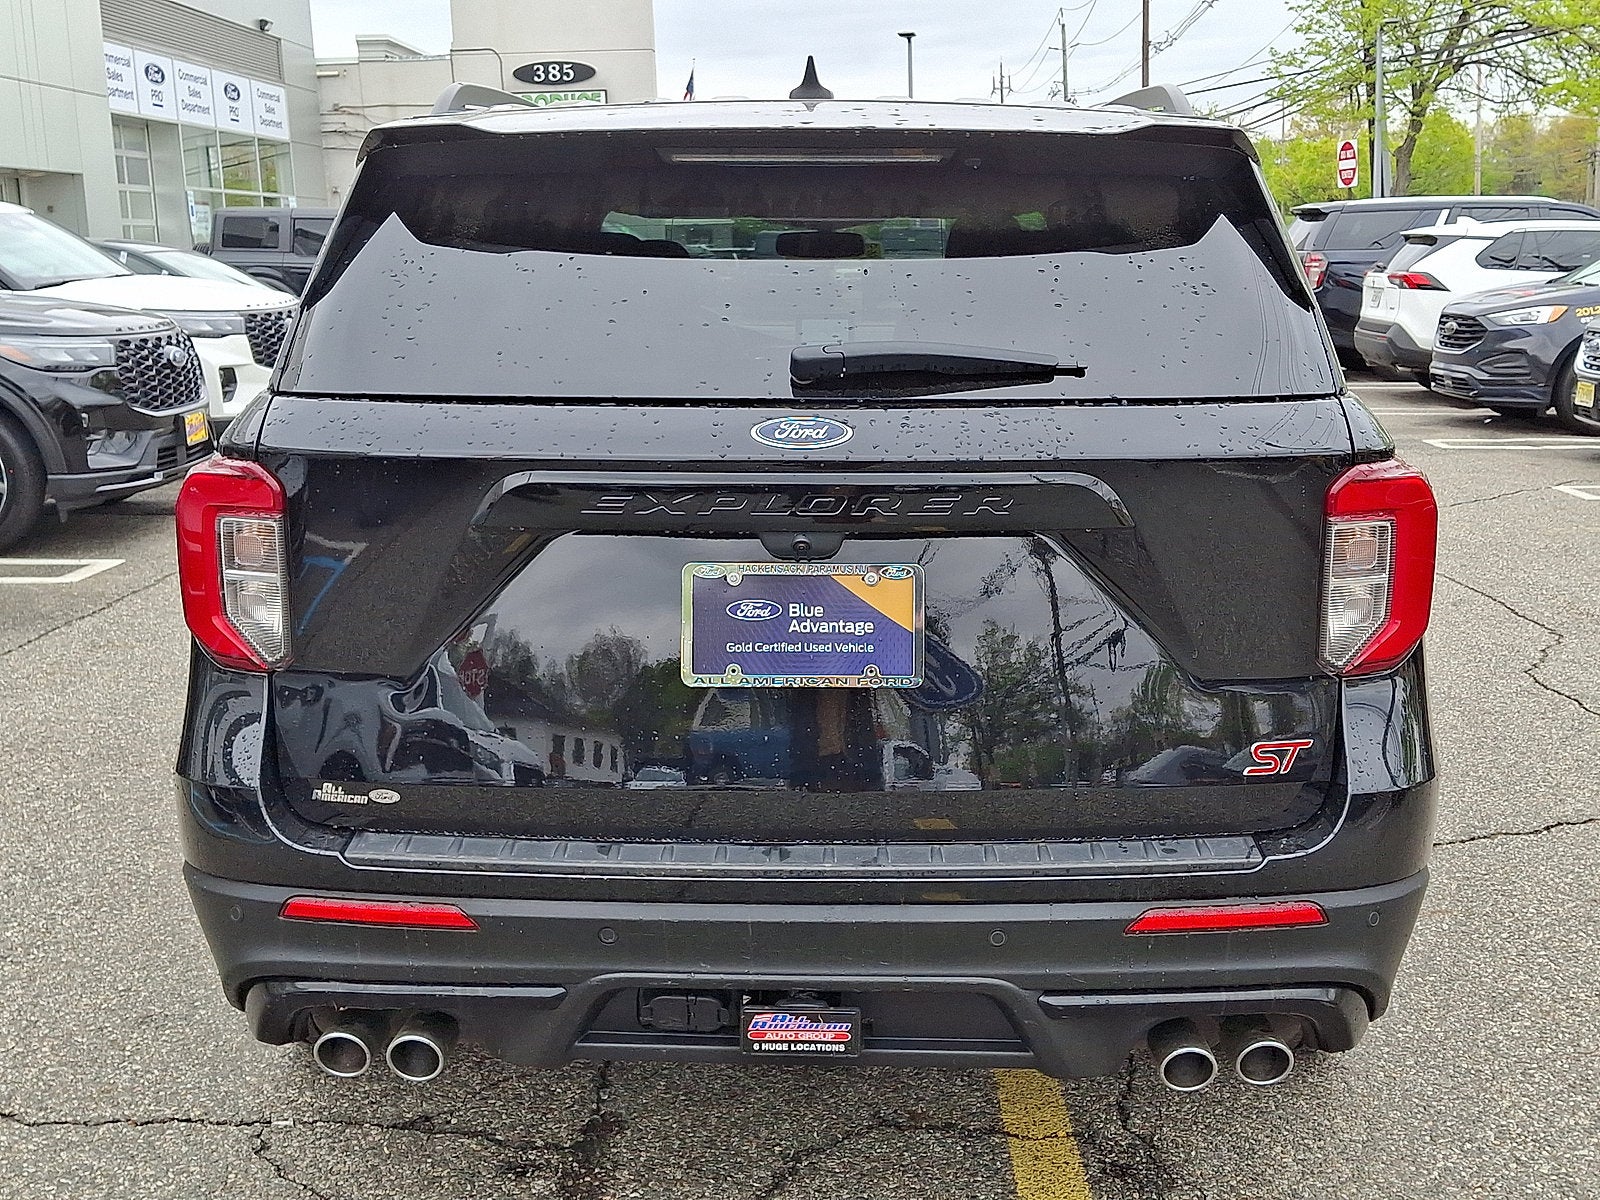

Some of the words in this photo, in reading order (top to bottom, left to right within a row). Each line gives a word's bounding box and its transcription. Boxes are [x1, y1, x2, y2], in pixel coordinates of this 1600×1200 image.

[178, 68, 208, 86] Commercial
[533, 64, 575, 82] 385
[150, 89, 163, 102] PRO
[188, 85, 202, 99] Sales
[256, 88, 281, 103] Commercial
[181, 99, 211, 116] Department
[229, 105, 240, 118] PRO
[264, 103, 276, 115] Sales
[259, 115, 283, 129] Department
[773, 418, 829, 441] Ford
[580, 494, 1014, 516] EXPLORER
[698, 565, 722, 576] Ford
[885, 565, 908, 577] Ford
[735, 601, 772, 618] Ford
[788, 603, 824, 618] Blue
[788, 619, 874, 636] Advantage
[726, 642, 751, 653] Gold
[754, 642, 801, 653] Certified
[804, 642, 831, 653] Used
[833, 642, 874, 653] Vehicle
[693, 676, 731, 686] ALL
[736, 676, 848, 686] AMERICAN
[857, 677, 914, 686] FORD
[1243, 739, 1314, 776] ST
[322, 782, 345, 794] ALL
[311, 789, 369, 804] AMERICAN
[766, 1032, 795, 1040] AUTO
[798, 1032, 836, 1040] GROUP
[753, 1043, 760, 1051] 6
[761, 1043, 789, 1051] HUGE
[791, 1043, 846, 1052] LOCATIONS
